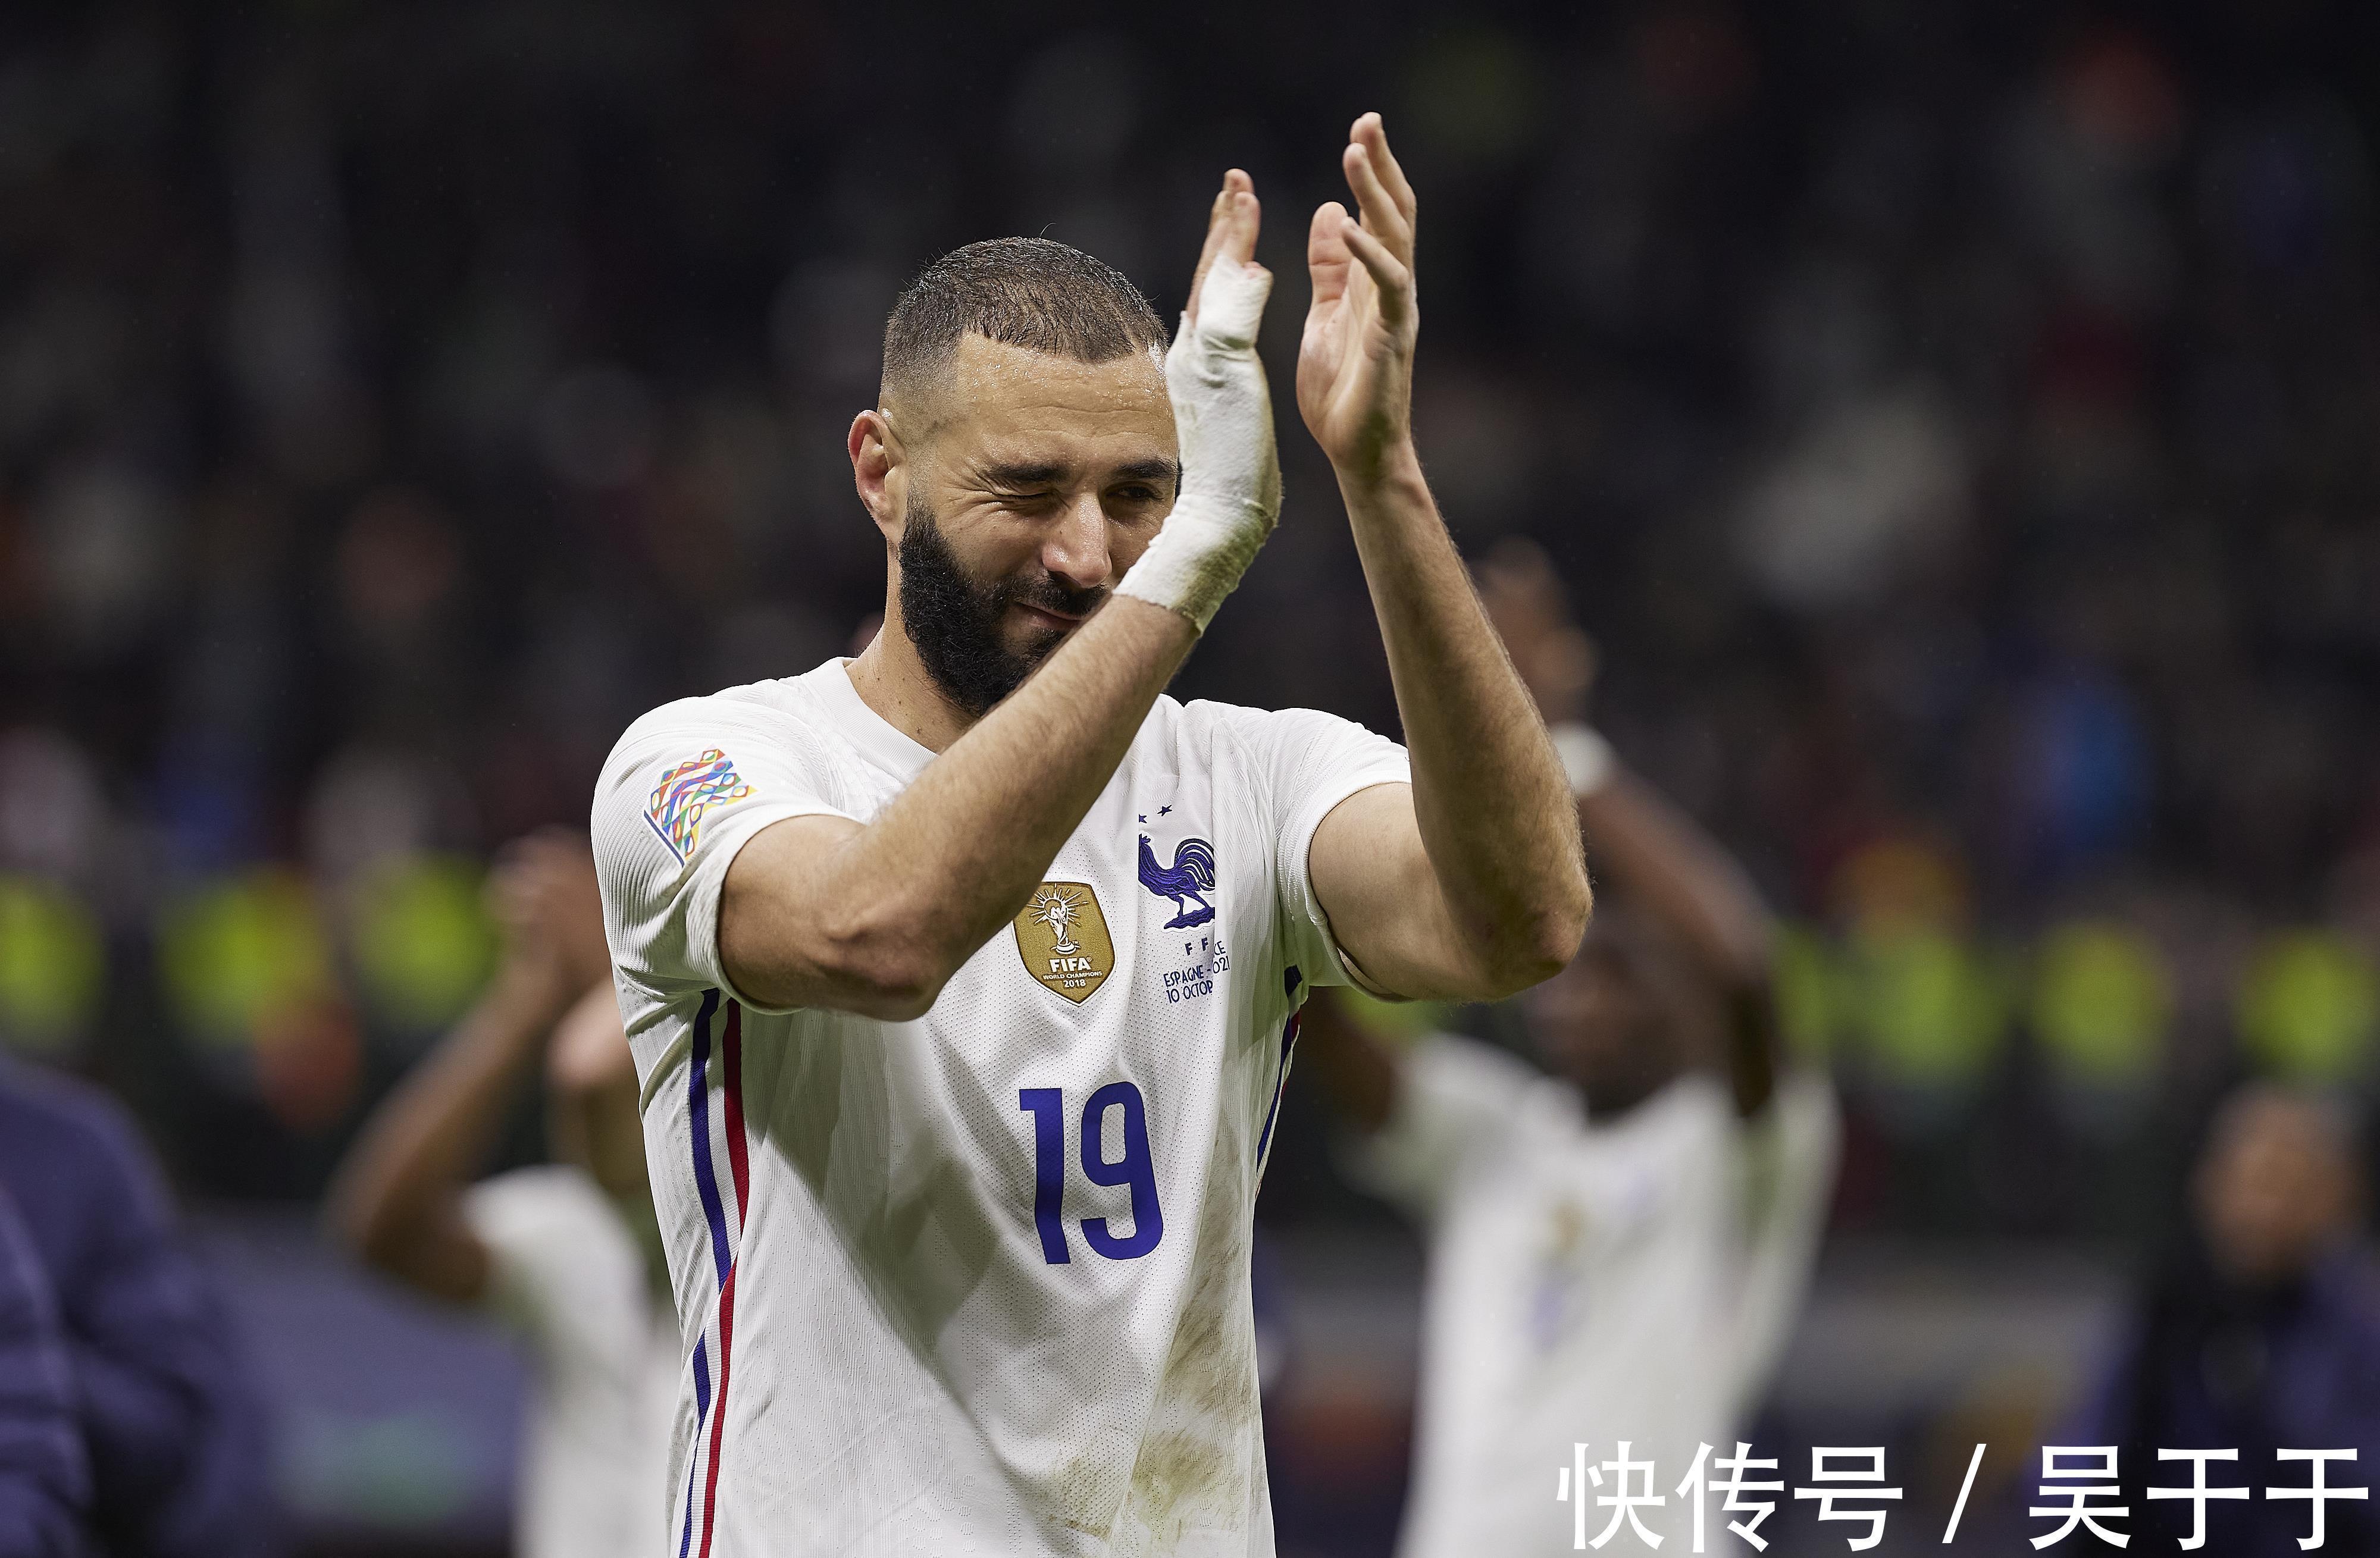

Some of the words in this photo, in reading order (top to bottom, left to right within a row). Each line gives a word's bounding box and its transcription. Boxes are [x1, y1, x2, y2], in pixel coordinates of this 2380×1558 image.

[1184, 942, 1192, 956] F
[1201, 937, 1208, 951] F
[1066, 970, 1103, 979] CHAMPIONS
[1163, 964, 1204, 988] ESPAGNE
[1213, 941, 1226, 955] CE
[1166, 988, 1180, 1004] 10
[1212, 955, 1230, 974] 021
[1063, 979, 1086, 988] 2018
[1019, 1081, 1164, 1265] 19
